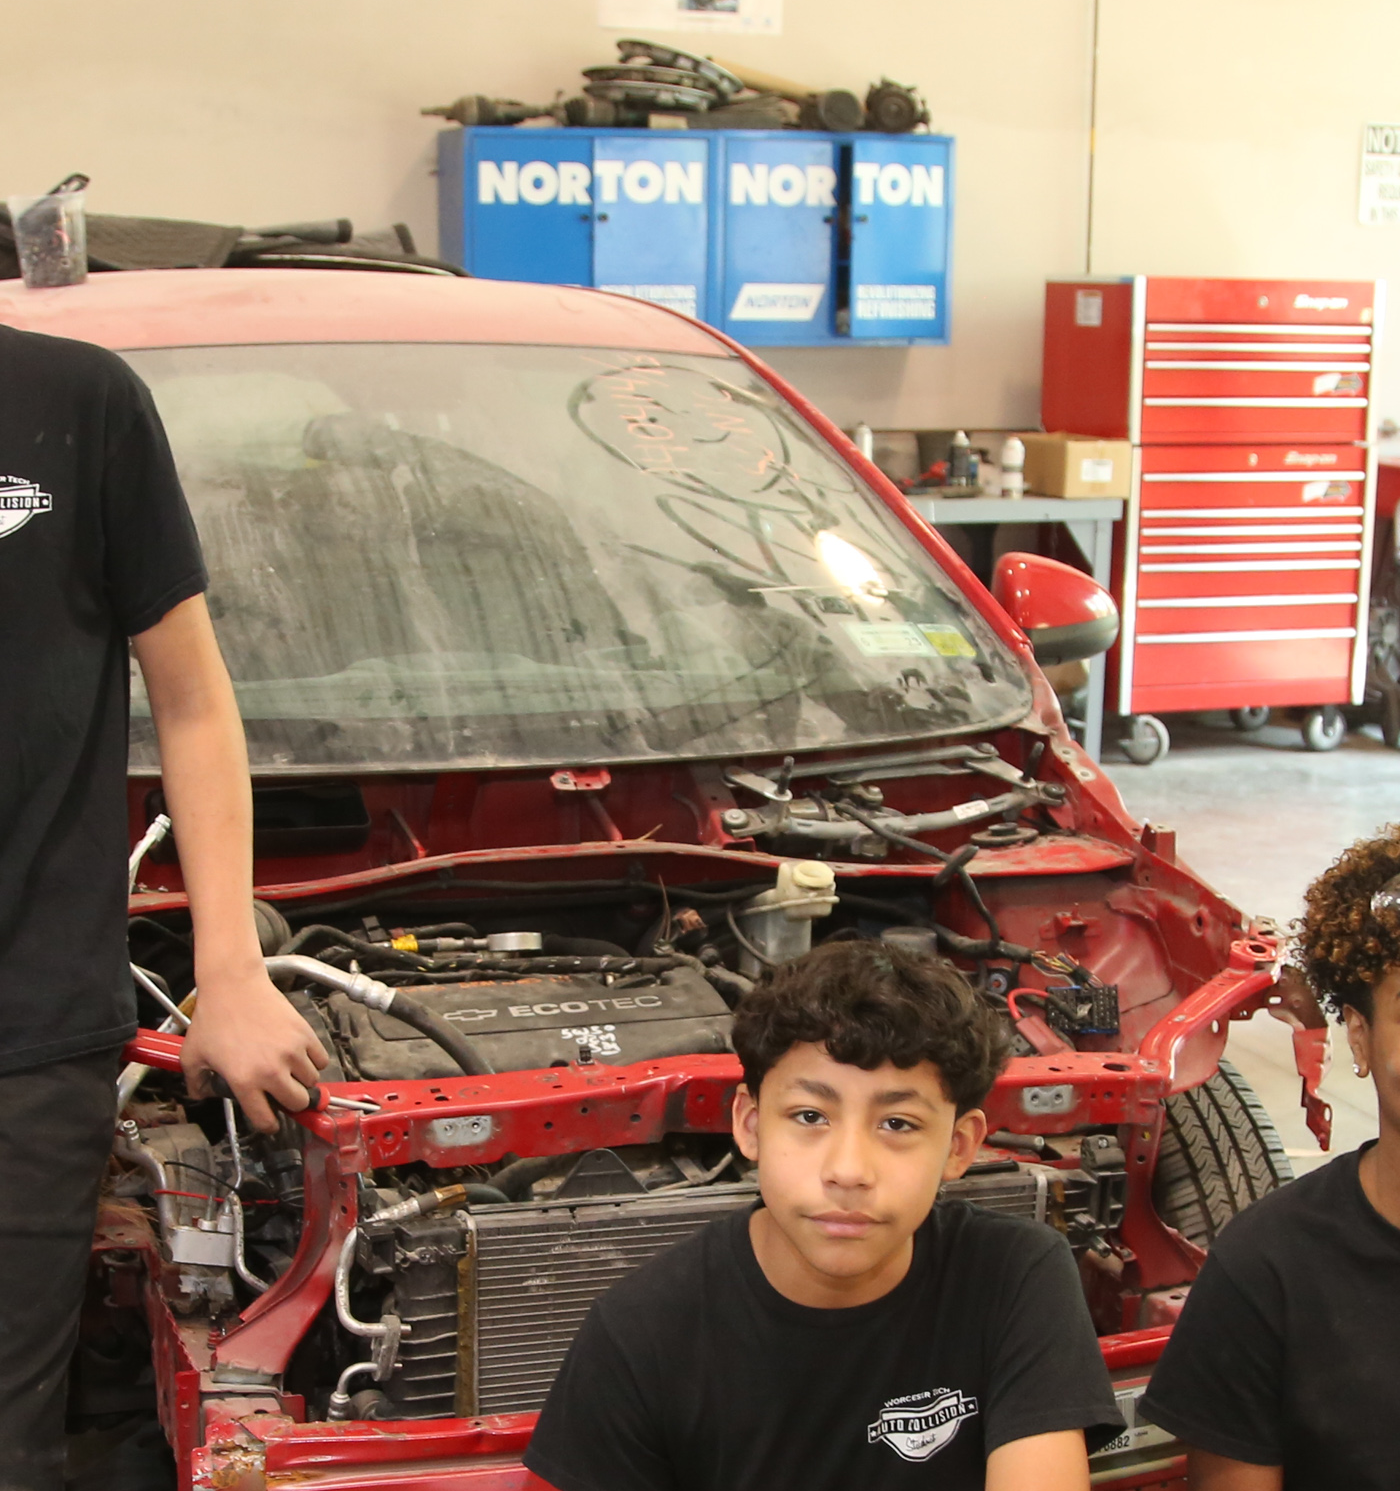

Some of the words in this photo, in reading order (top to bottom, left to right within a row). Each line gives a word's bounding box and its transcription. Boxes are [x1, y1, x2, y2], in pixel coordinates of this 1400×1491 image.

[478, 159, 703, 205] NORTON
[730, 162, 944, 207] NORTON
[743, 294, 813, 309] NORTON
[7, 475, 31, 485] TECH
[508, 995, 662, 1018] ECOTEC
